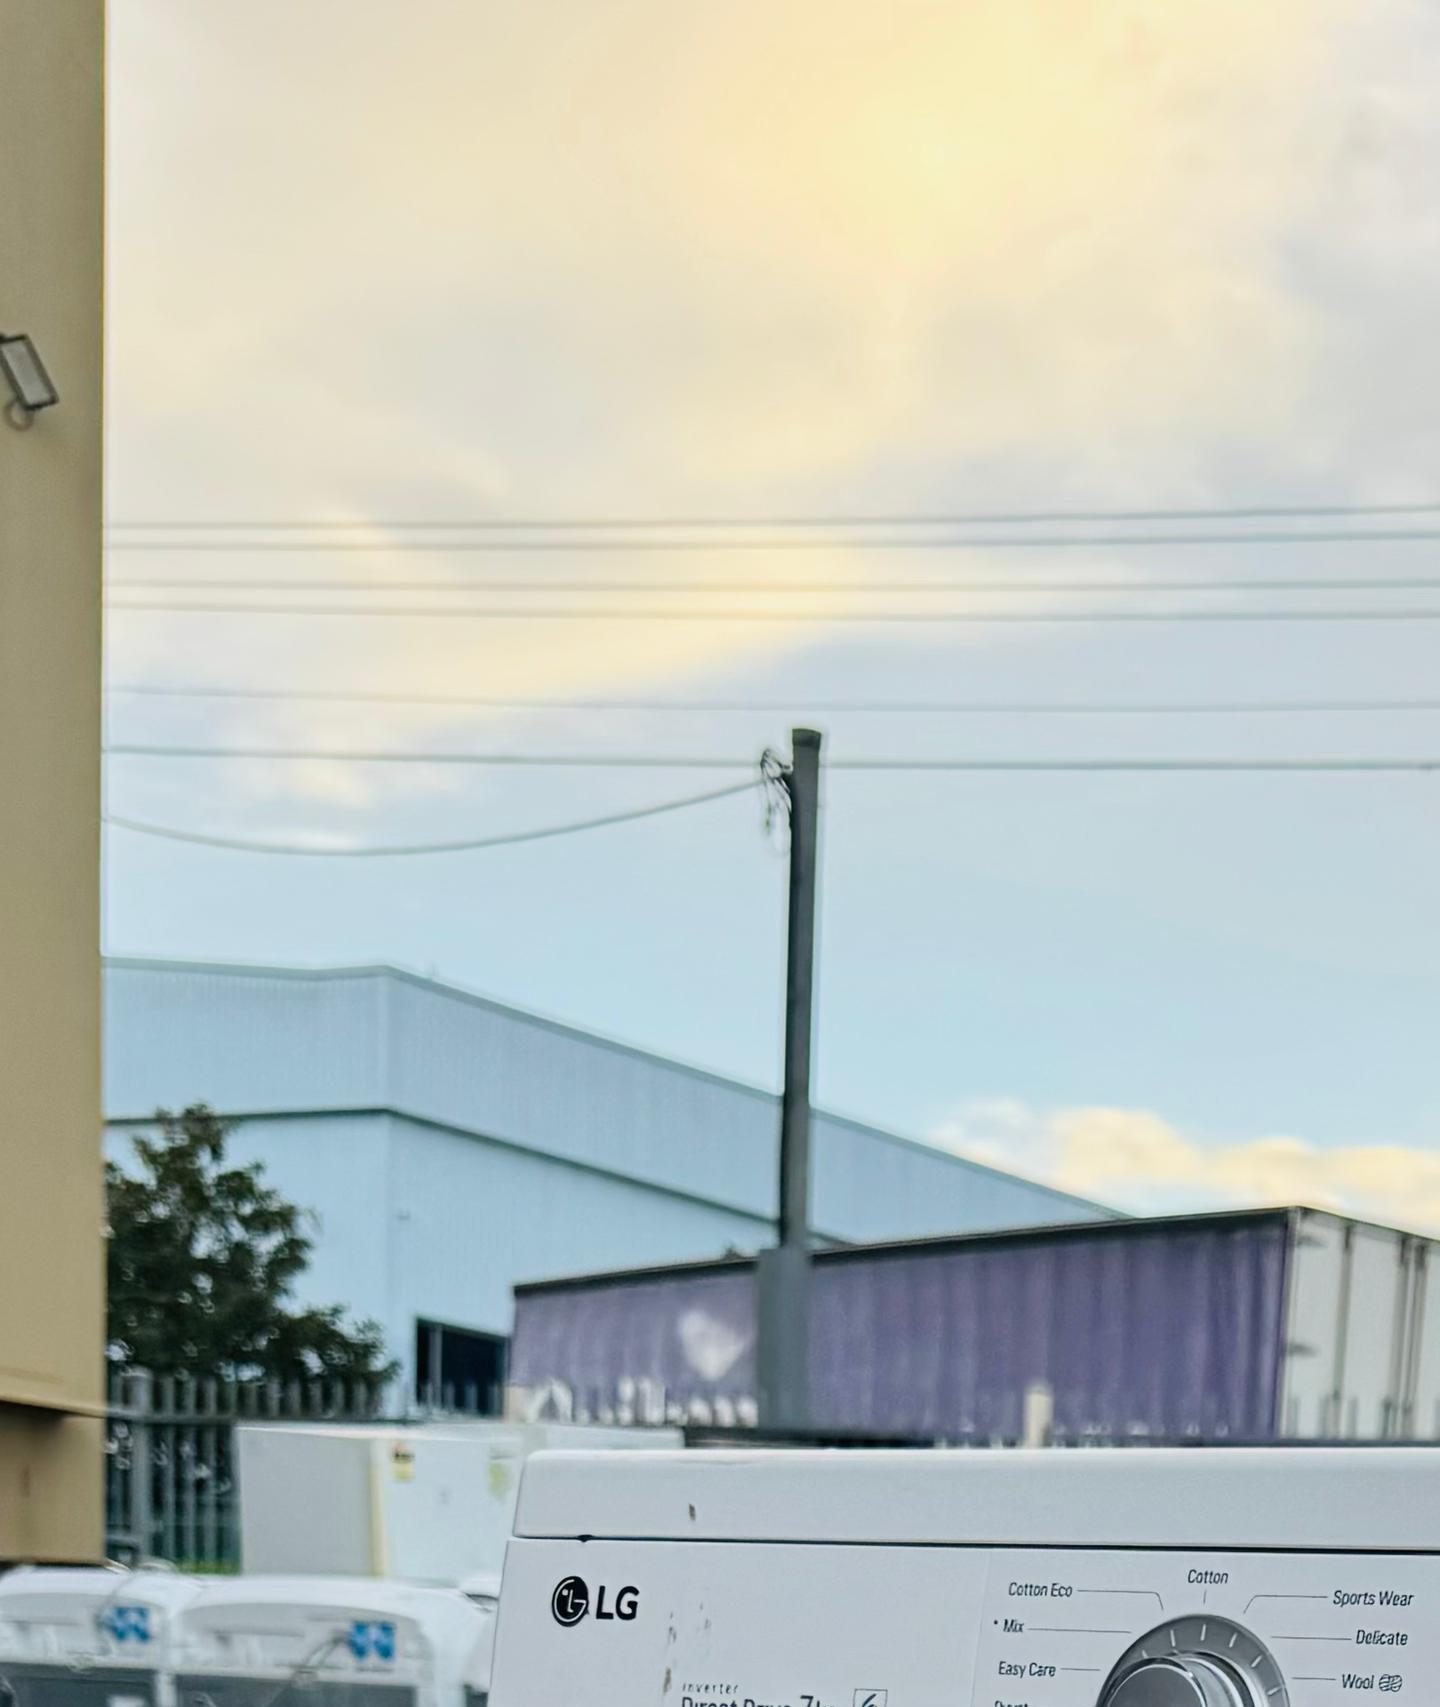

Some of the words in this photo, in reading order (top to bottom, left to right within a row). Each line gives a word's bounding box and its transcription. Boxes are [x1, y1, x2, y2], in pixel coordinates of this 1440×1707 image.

[1188, 1569, 1229, 1584] Cotton
[1008, 1582, 1048, 1597] Cotton
[1050, 1583, 1073, 1597] Eco
[596, 1585, 640, 1620] LG
[1333, 1590, 1376, 1608] Sports
[1378, 1590, 1414, 1606] Wear
[1003, 1619, 1024, 1633] Mix
[1356, 1629, 1408, 1646] Delicate
[998, 1661, 1026, 1679] Easy
[1029, 1662, 1056, 1677] Care
[1342, 1674, 1374, 1689] Wool
